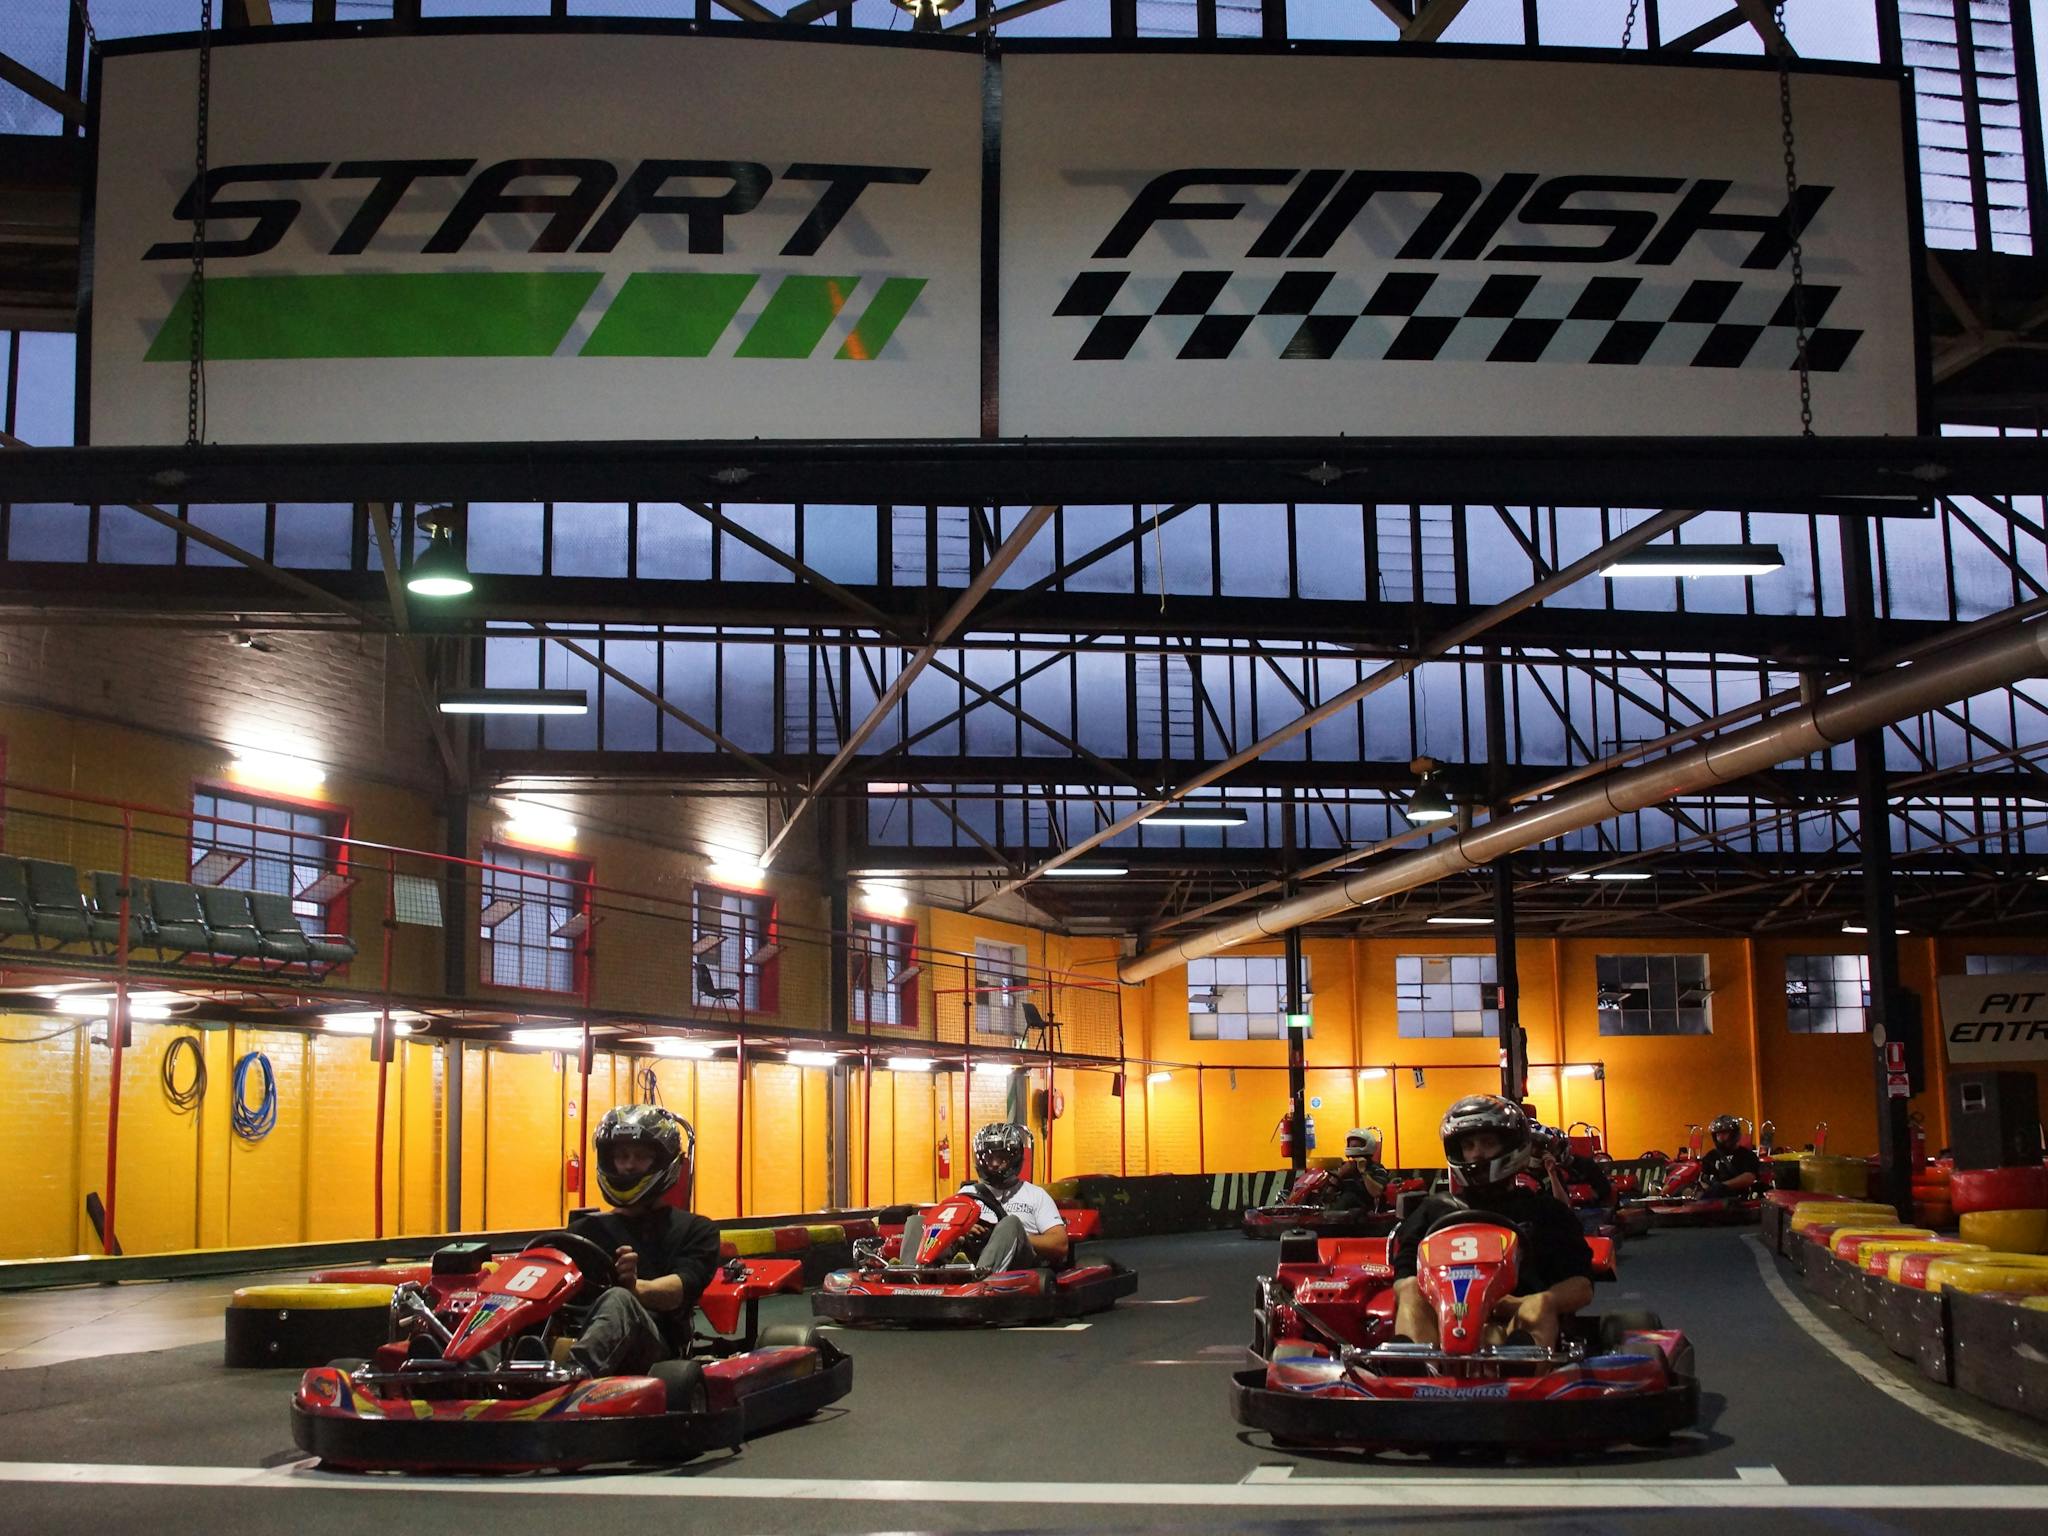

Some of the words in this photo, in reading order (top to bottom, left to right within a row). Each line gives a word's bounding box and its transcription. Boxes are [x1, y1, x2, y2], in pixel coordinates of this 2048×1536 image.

[141, 158, 932, 261] START
[1090, 168, 1834, 269] FINISH
[1979, 992, 2046, 1015] PIT
[937, 1206, 958, 1223] 4
[1450, 1236, 1479, 1262] 3
[504, 1265, 548, 1293] 6
